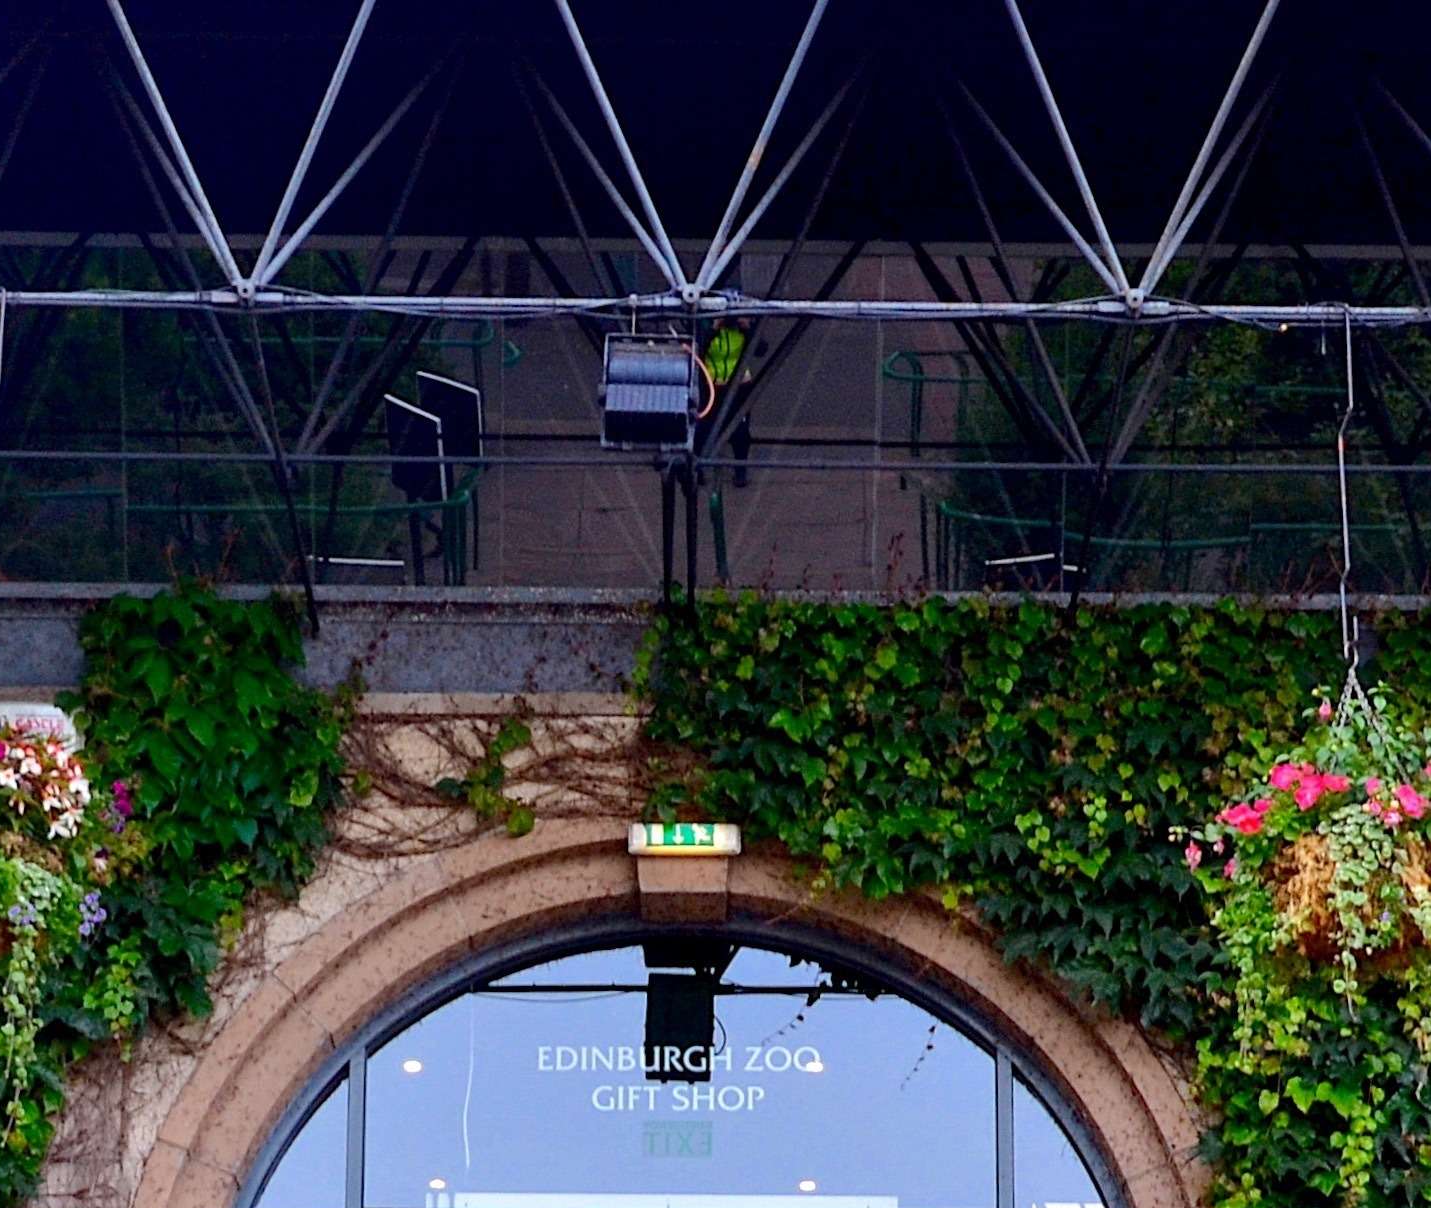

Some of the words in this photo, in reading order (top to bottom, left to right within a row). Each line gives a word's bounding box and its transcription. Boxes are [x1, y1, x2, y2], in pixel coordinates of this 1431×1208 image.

[538, 1046, 732, 1072] EDINBURGH
[744, 1046, 822, 1072] ZOO
[592, 1085, 660, 1111] GIFT
[672, 1085, 765, 1111] SHOP
